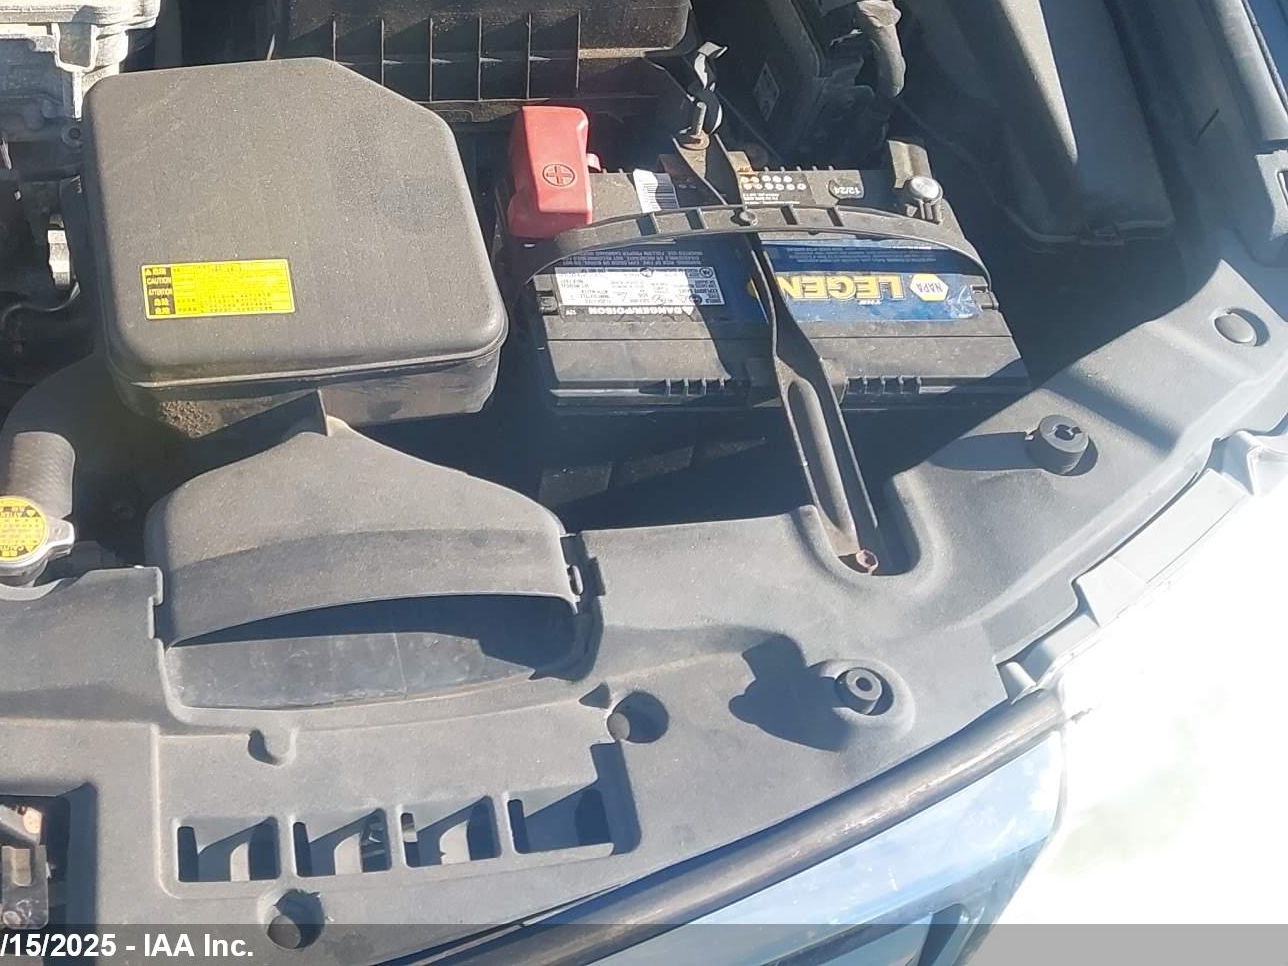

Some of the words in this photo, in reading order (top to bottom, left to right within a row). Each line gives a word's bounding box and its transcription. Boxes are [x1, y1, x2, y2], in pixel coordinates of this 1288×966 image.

[833, 186, 861, 196] 12/24
[147, 276, 171, 284] CAUTION
[768, 275, 905, 301] LEGEN
[915, 282, 943, 293] NAPA
